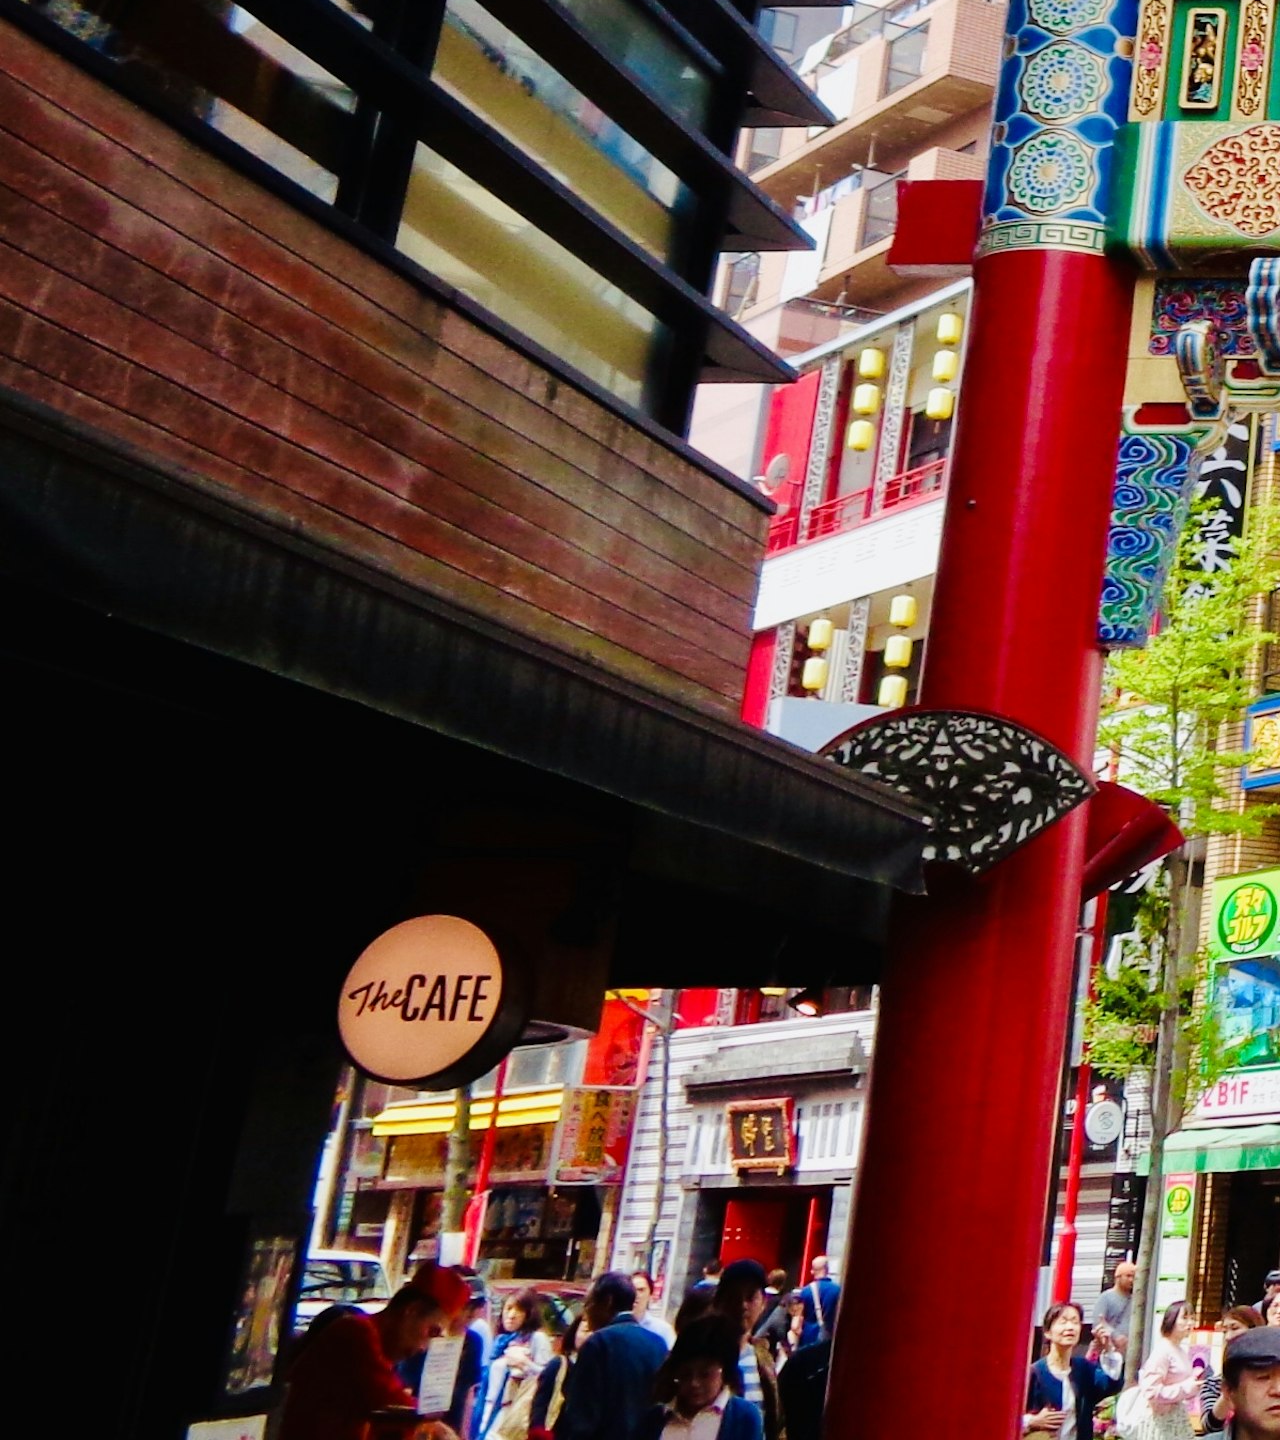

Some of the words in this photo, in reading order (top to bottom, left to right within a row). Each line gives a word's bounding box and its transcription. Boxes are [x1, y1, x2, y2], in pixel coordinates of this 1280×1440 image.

[1227, 913, 1267, 943] ゴルフ
[348, 980, 404, 1017] The
[401, 974, 492, 1022] CAFE
[1217, 1081, 1249, 1107] B1F
